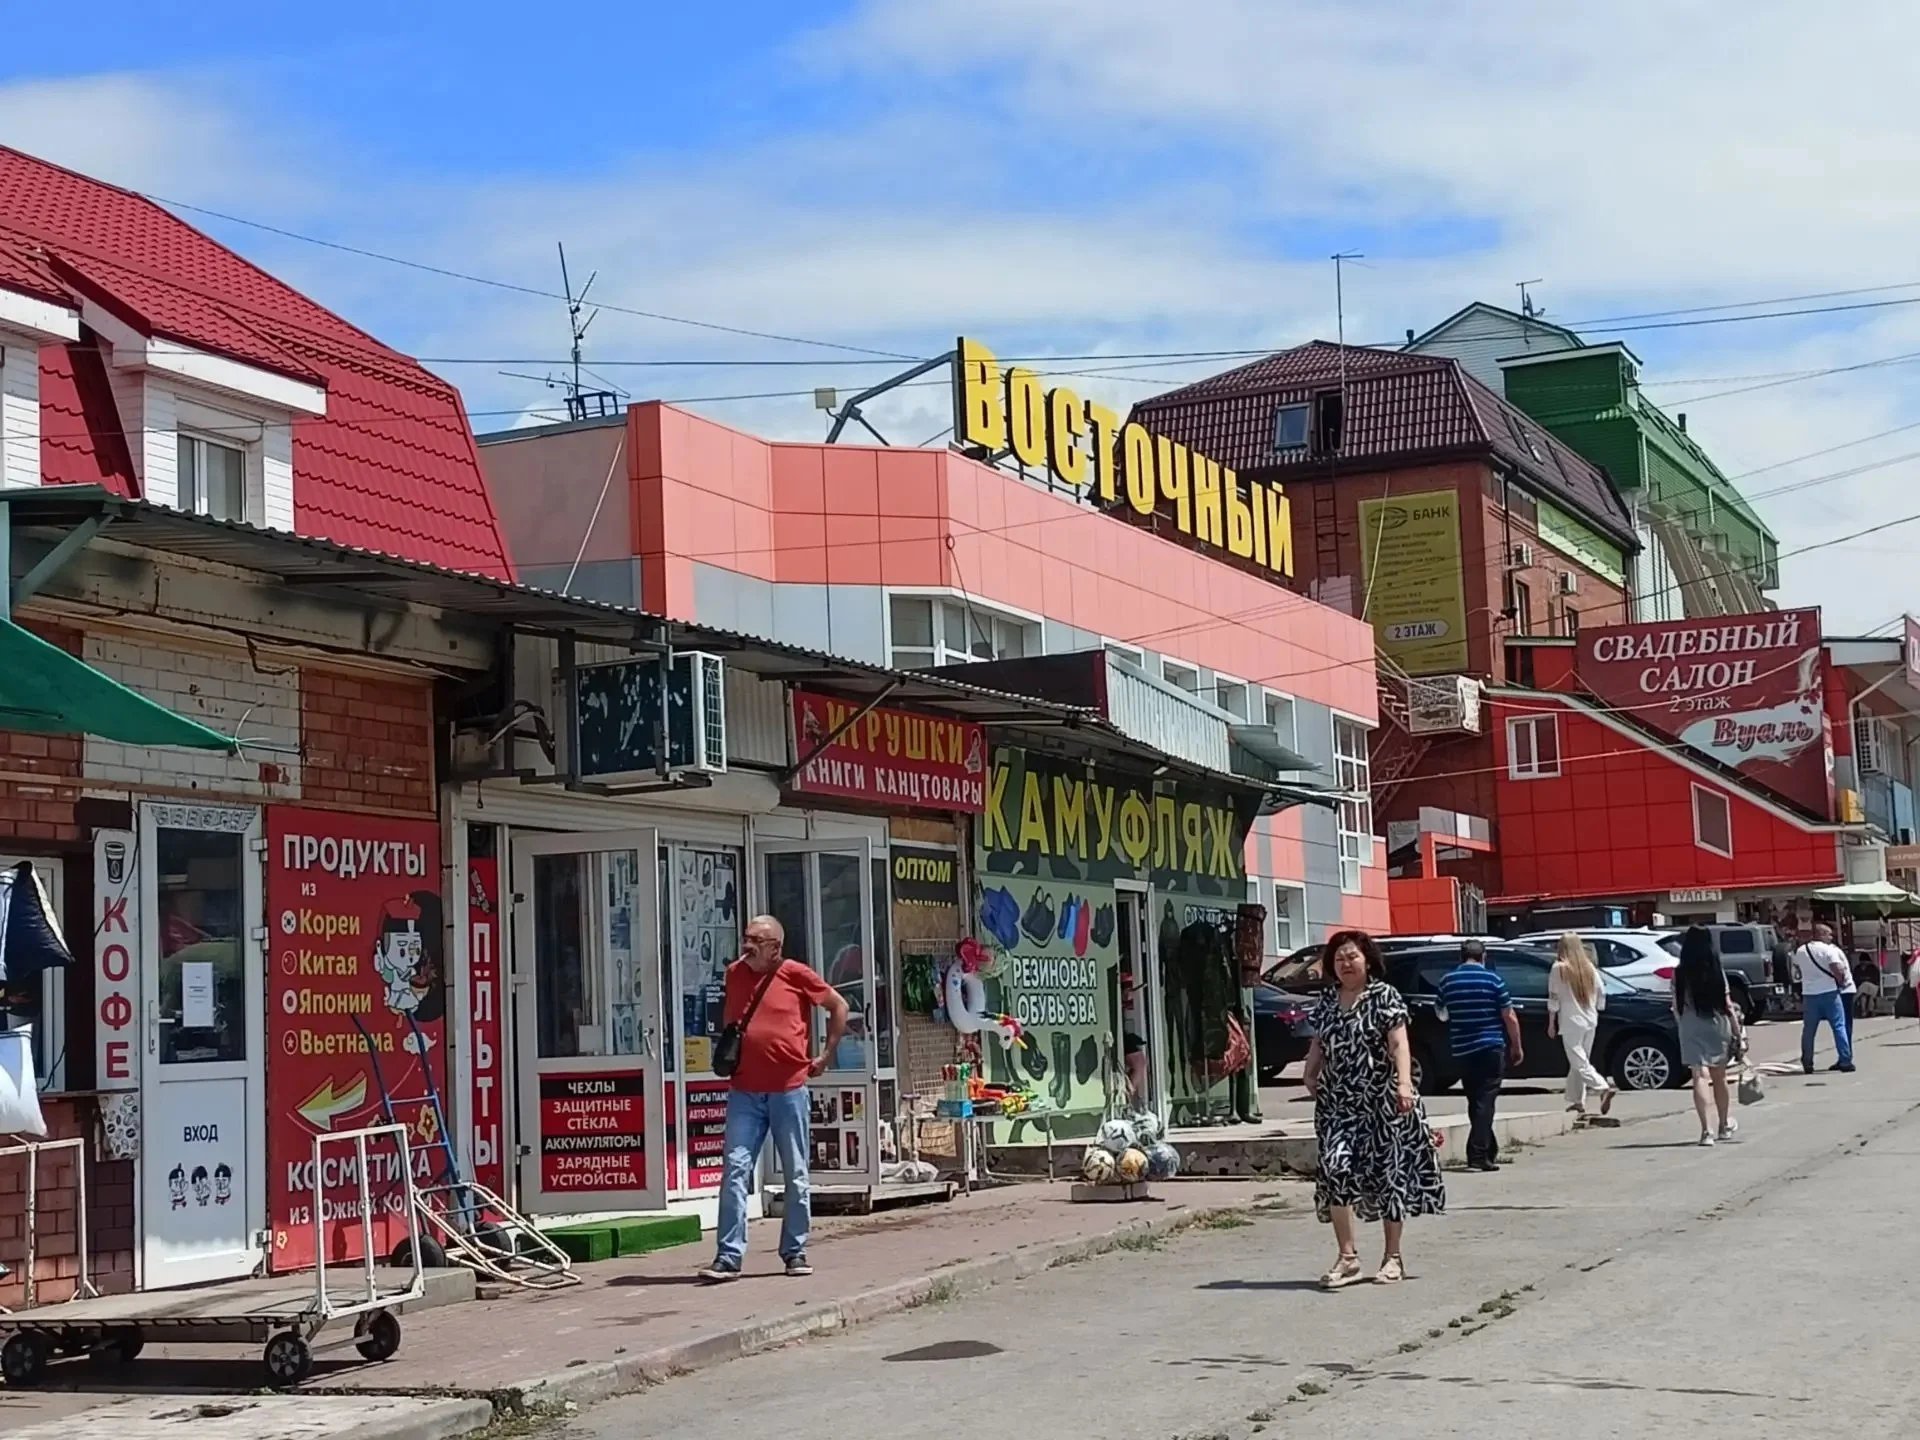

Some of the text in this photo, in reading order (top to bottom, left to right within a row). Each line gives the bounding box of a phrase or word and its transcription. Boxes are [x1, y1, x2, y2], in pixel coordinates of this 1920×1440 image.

[960, 337, 1294, 576] ВОСТОЧНЫЙ
[1413, 506, 1450, 521] БАНК
[1394, 622, 1436, 639] 2 ЭТАЖ
[1593, 614, 1801, 662] СВАДЕБНЫЙ
[1640, 659, 1756, 693] САЛОН
[1669, 695, 1732, 713] 2 этаж
[826, 701, 963, 765] ИГРУШКИ
[1712, 718, 1814, 751] Вуаль
[806, 757, 983, 807] КНИГИ КАНЦТОВАРЫ
[983, 766, 1238, 879] КАМУФЛЯЖ
[283, 834, 426, 879] ПРОДУКТЫ
[895, 856, 951, 883] ОПТОМ
[301, 882, 317, 896] из
[300, 908, 360, 941] Кореи
[300, 949, 358, 976] Китая
[1013, 957, 1097, 988] РЕЗИНОВАЯ
[100, 895, 132, 1079] КОФЕ
[299, 988, 372, 1015] Японии
[1018, 994, 1097, 1025] ОБУВЬ ЭВА
[300, 1029, 395, 1055] Вьетнама
[473, 922, 498, 1165] ПЛЬТЫ
[568, 1081, 615, 1094] ЧЕХЛЫ
[553, 1099, 631, 1114] ЗАЩИТНЫЕ
[184, 1124, 219, 1143] ВХОД
[567, 1114, 618, 1130] СТЁКЛА
[545, 1135, 641, 1150] АККУМУЛЯТОРЫ
[287, 1149, 432, 1192] КОСМТИА
[557, 1155, 630, 1170] ЗАРЯДНЫЕ
[550, 1170, 637, 1186] УСТРОЙСТВА
[290, 1206, 310, 1225] из
